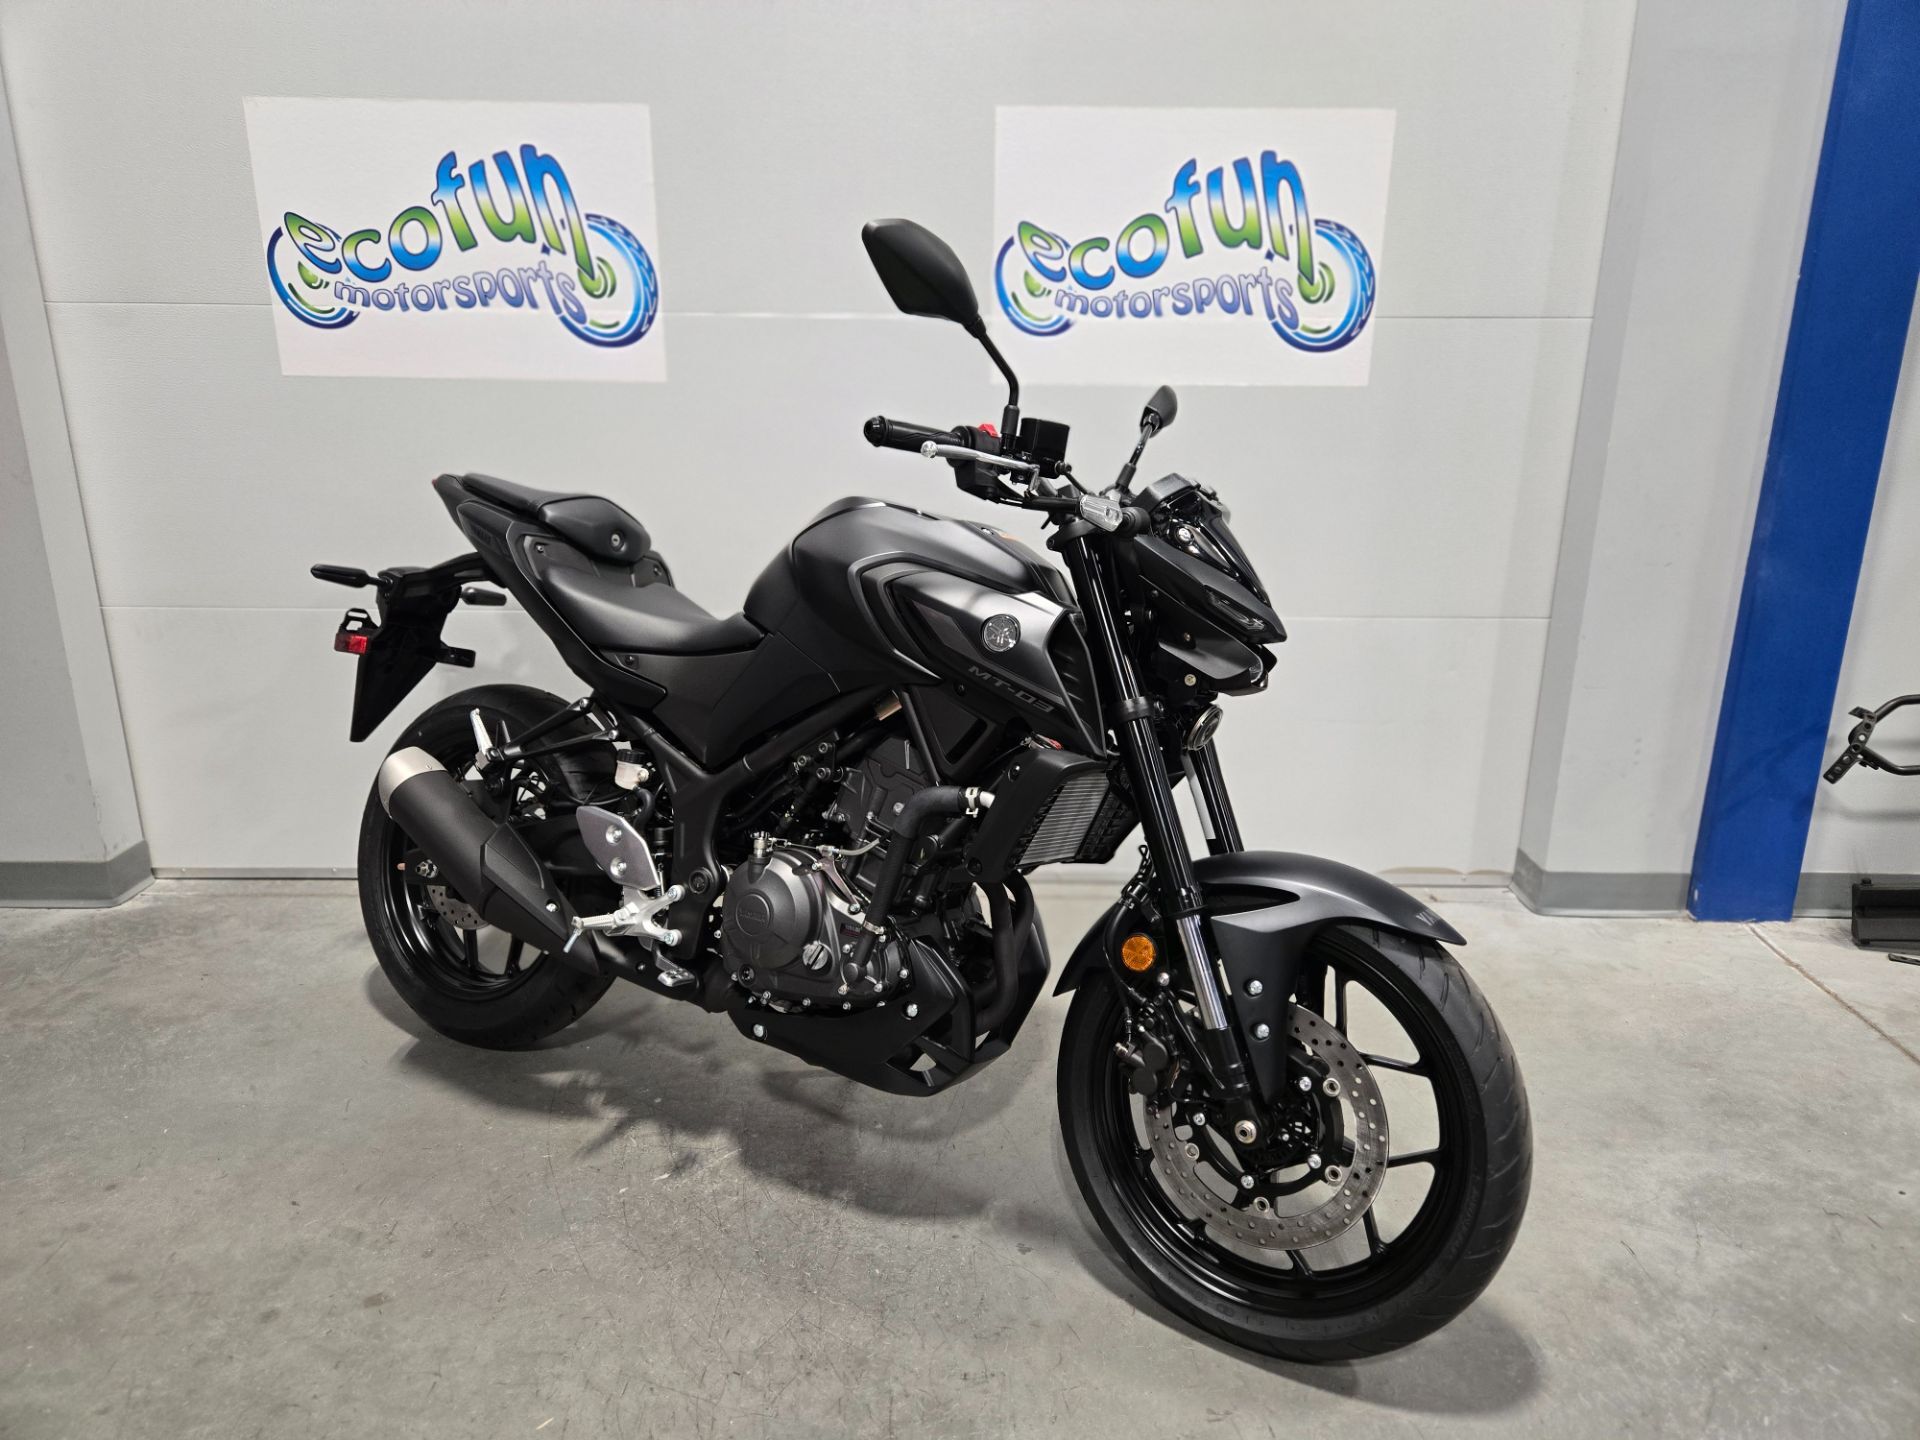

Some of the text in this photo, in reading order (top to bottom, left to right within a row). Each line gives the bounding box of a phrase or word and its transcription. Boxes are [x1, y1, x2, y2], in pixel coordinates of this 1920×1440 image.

[334, 260, 587, 325] motorsports
[1055, 266, 1299, 331] motorsports
[968, 665, 1054, 712] MT-03
